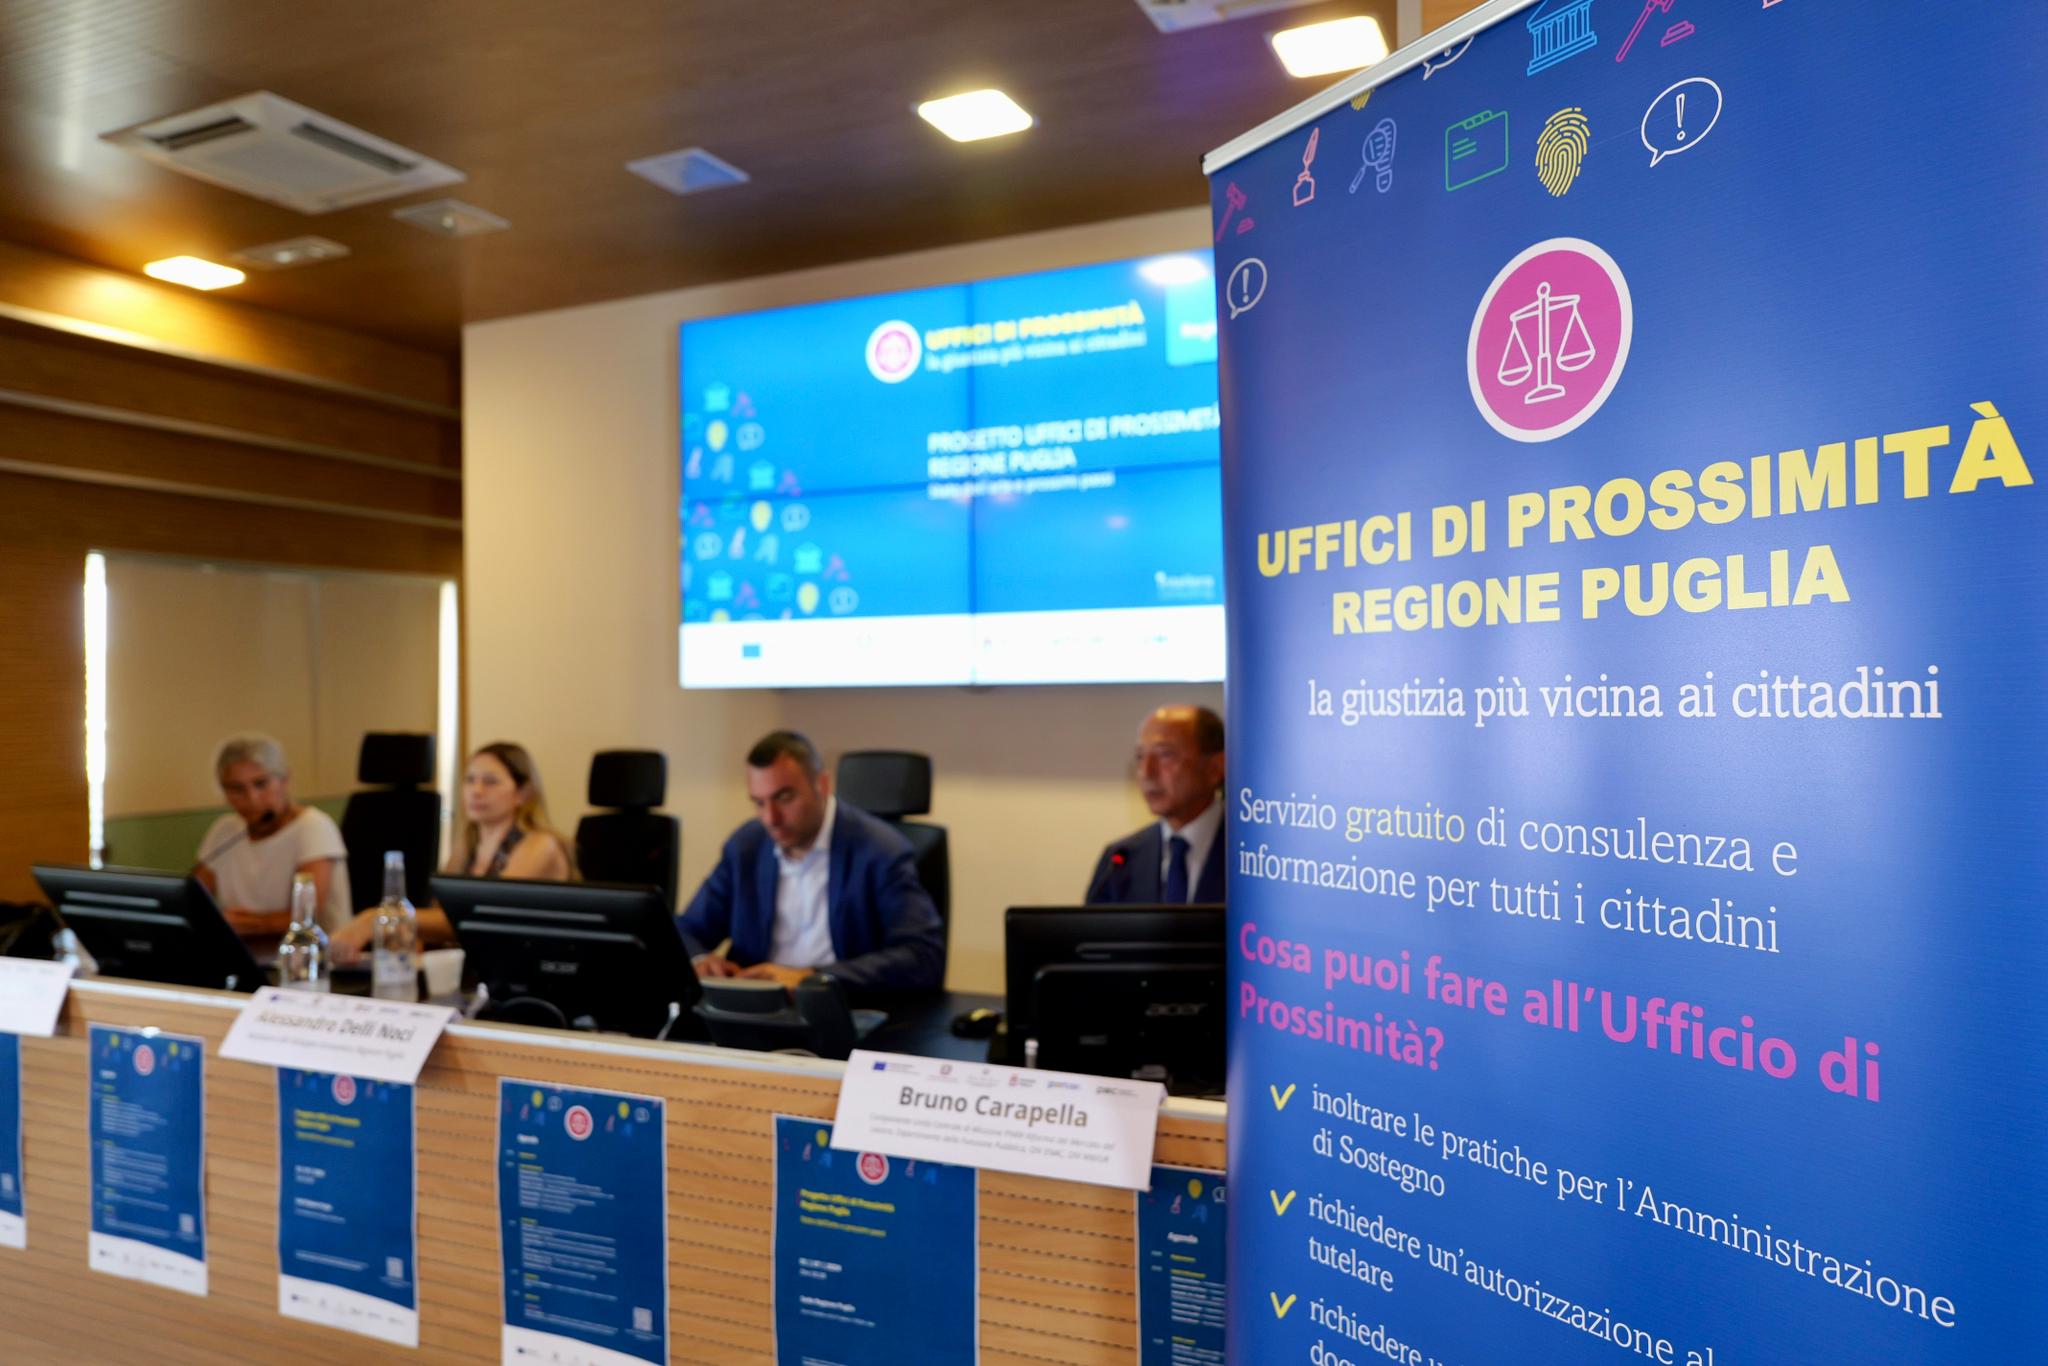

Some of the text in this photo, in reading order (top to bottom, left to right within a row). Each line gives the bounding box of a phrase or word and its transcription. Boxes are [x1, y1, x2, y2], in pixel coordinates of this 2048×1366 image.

[1257, 400, 2035, 578] UFFICI DI PROSSIMITÀ
[1331, 543, 1851, 636] REGIONE PUGLIA
[1308, 665, 1943, 728] la giustizia più vicina ai cittadini
[1239, 787, 1798, 877] Servizio gratuito di consulenza e
[1239, 841, 1780, 953] informazione per tutti i cittadini
[1239, 921, 1881, 1103] Cosa puoi fare all'Ufficio di
[1240, 982, 1445, 1072] Prossimità?
[899, 1085, 1088, 1128] Bruno Carapella
[1311, 1083, 1957, 1329] inoltrare le pratiche per l'Amministrazione
[1312, 1127, 1446, 1198] di Sostegno
[1308, 1192, 1421, 1259] richiedere
[1427, 1248, 1675, 1366] un'autorizzazione
[1309, 1235, 1395, 1293] tutelare
[1310, 1297, 1423, 1366] richiedere
